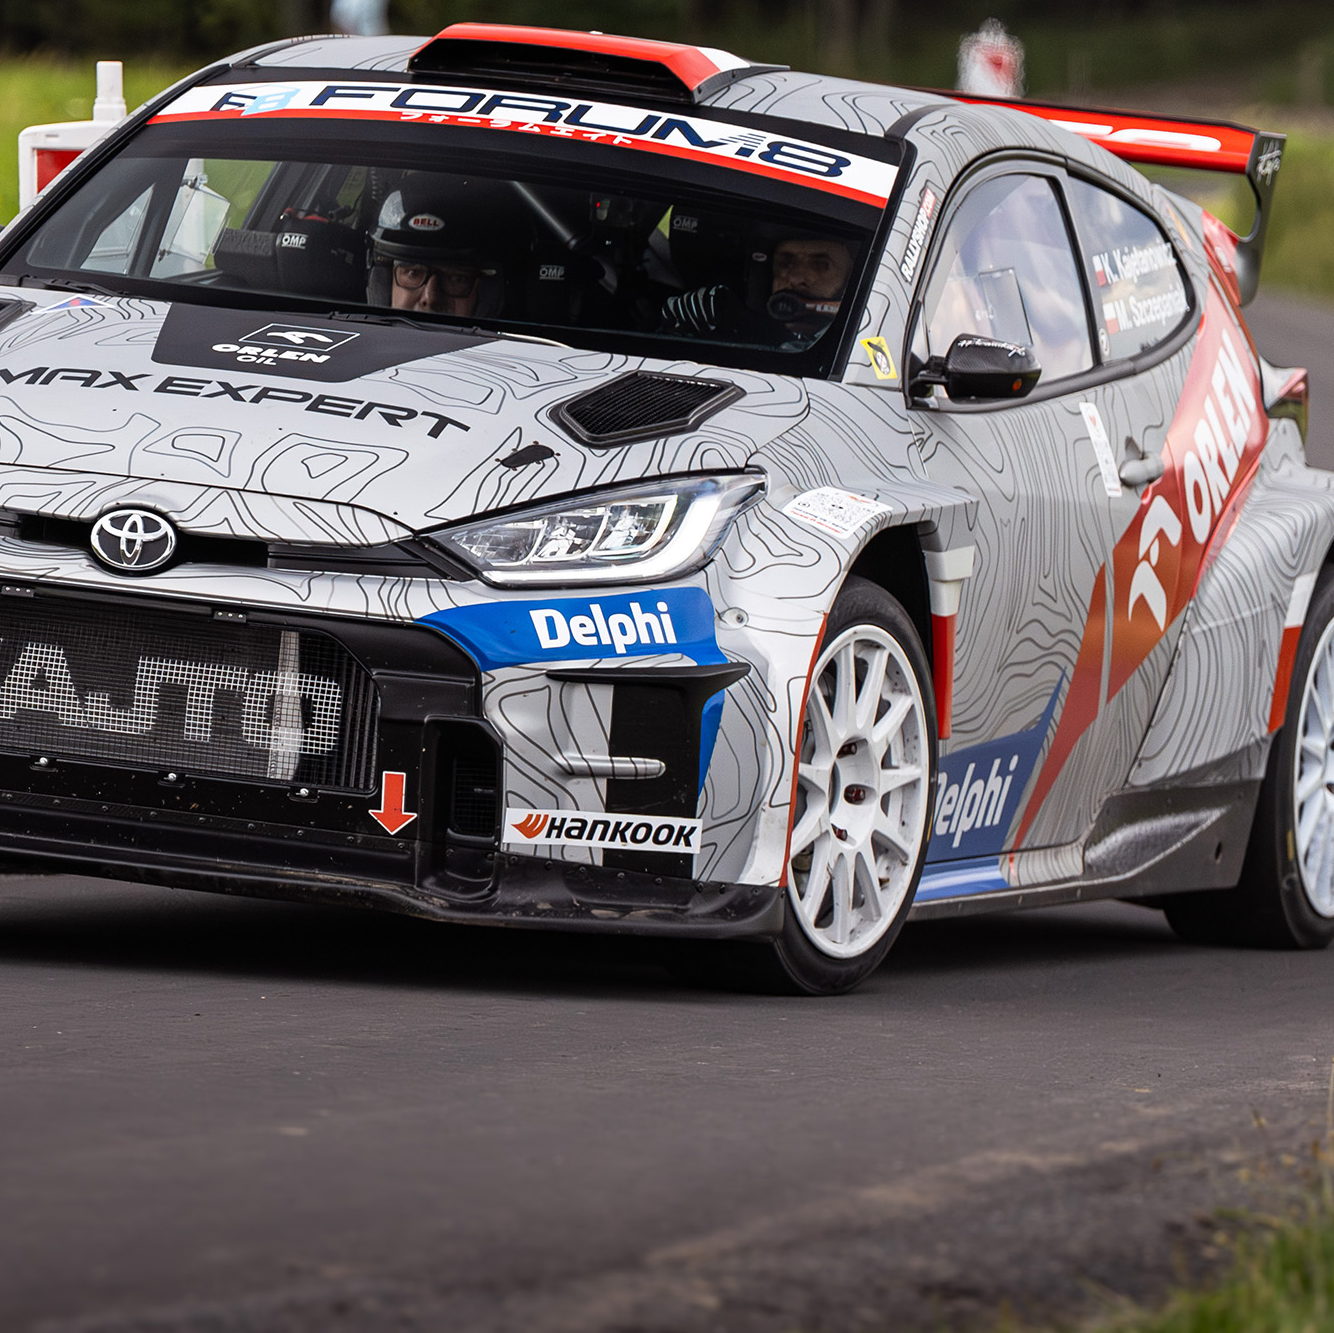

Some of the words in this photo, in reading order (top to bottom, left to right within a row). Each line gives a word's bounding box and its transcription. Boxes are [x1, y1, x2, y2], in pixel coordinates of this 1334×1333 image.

[309, 85, 852, 178] FORUM8
[400, 111, 633, 146] フォーラムエイト
[413, 218, 440, 228] BELL
[673, 217, 698, 229] OMP
[281, 234, 307, 248] OMP
[539, 267, 565, 277] OMP
[212, 343, 331, 364] ORLEN
[236, 354, 277, 366] OIL
[153, 375, 471, 440] EXPERT
[1183, 328, 1257, 544] ORLEN
[529, 601, 677, 654] Delphi
